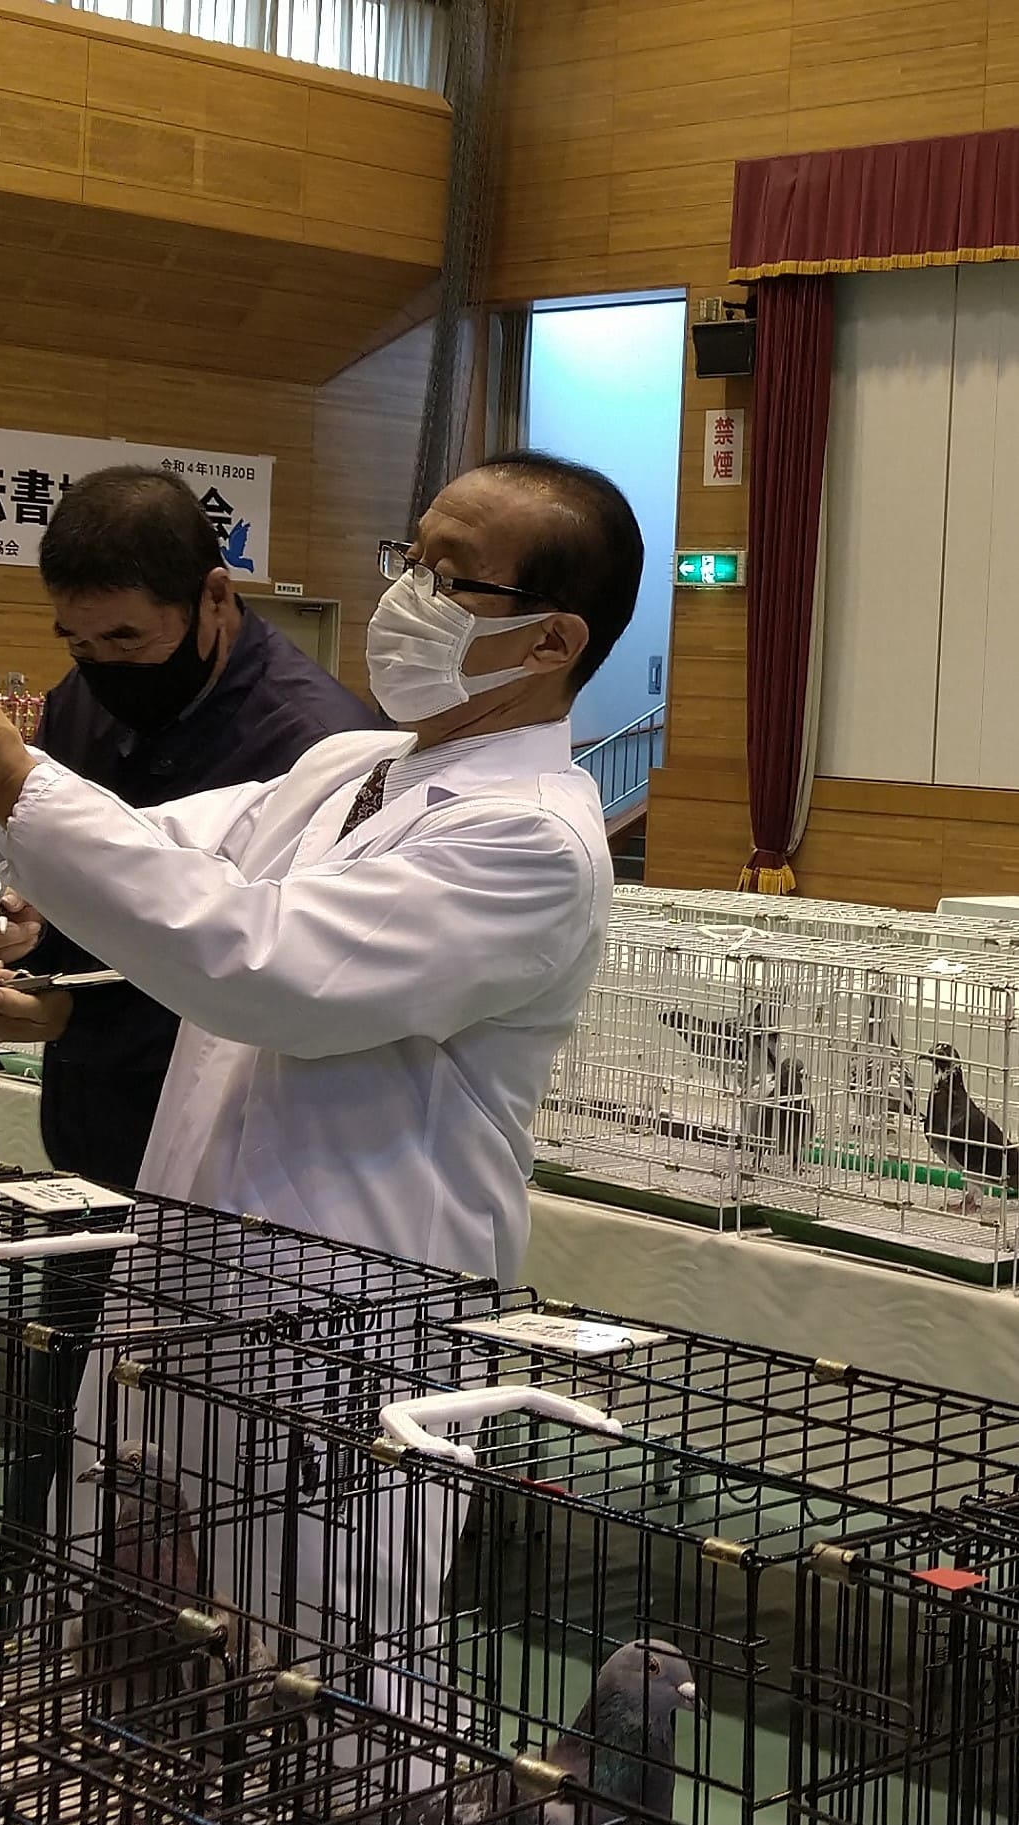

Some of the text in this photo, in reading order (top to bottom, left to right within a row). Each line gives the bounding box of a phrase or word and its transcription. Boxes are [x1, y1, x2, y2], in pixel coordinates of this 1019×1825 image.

[161, 458, 255, 480] 令和4年11月20日
[712, 416, 735, 480] 禁煙
